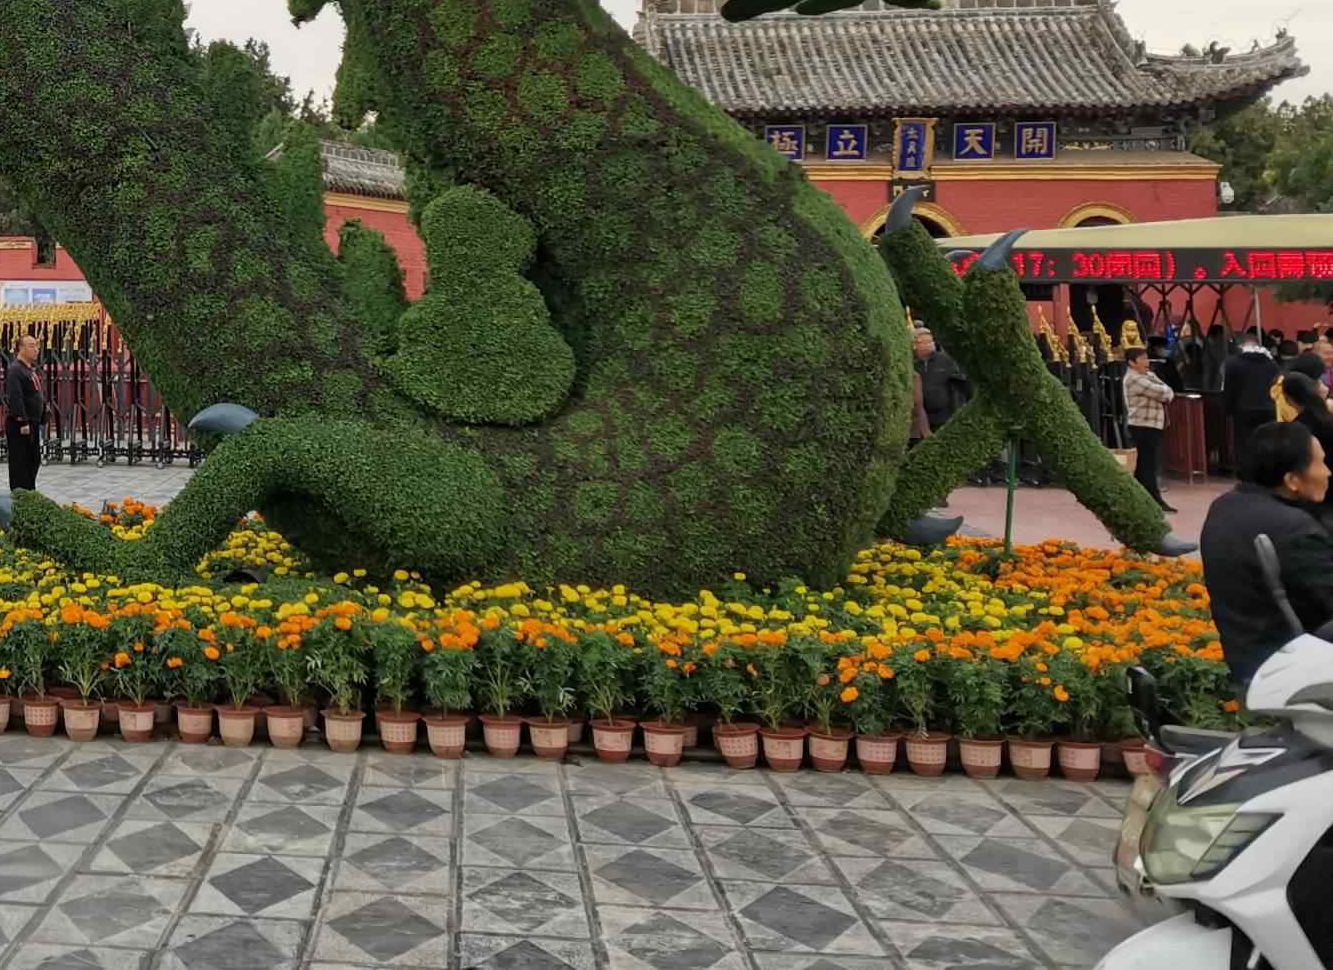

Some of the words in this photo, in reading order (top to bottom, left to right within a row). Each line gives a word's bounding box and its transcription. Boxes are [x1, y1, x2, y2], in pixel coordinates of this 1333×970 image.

[833, 130, 860, 156] 立
[961, 129, 987, 156] 天
[1021, 127, 1047, 155] 開
